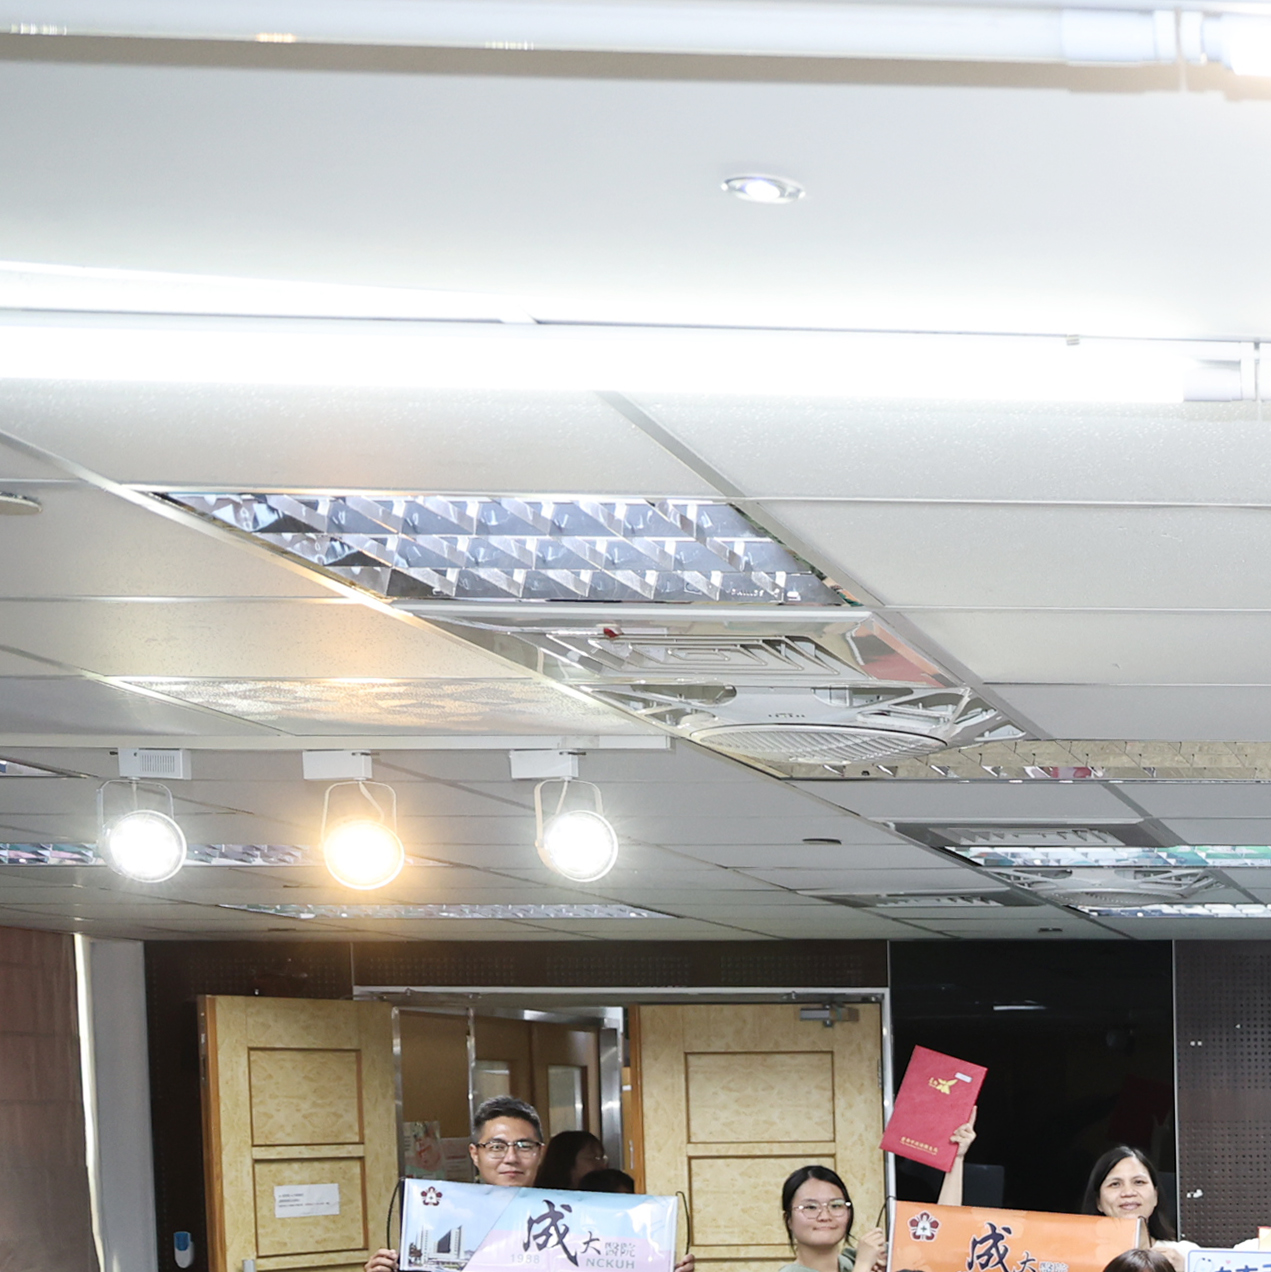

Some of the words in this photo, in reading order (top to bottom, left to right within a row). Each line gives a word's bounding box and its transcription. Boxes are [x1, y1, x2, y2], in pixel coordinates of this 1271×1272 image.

[522, 1199, 636, 1268] 成大醫院
[585, 1256, 636, 1270] NCKUH
